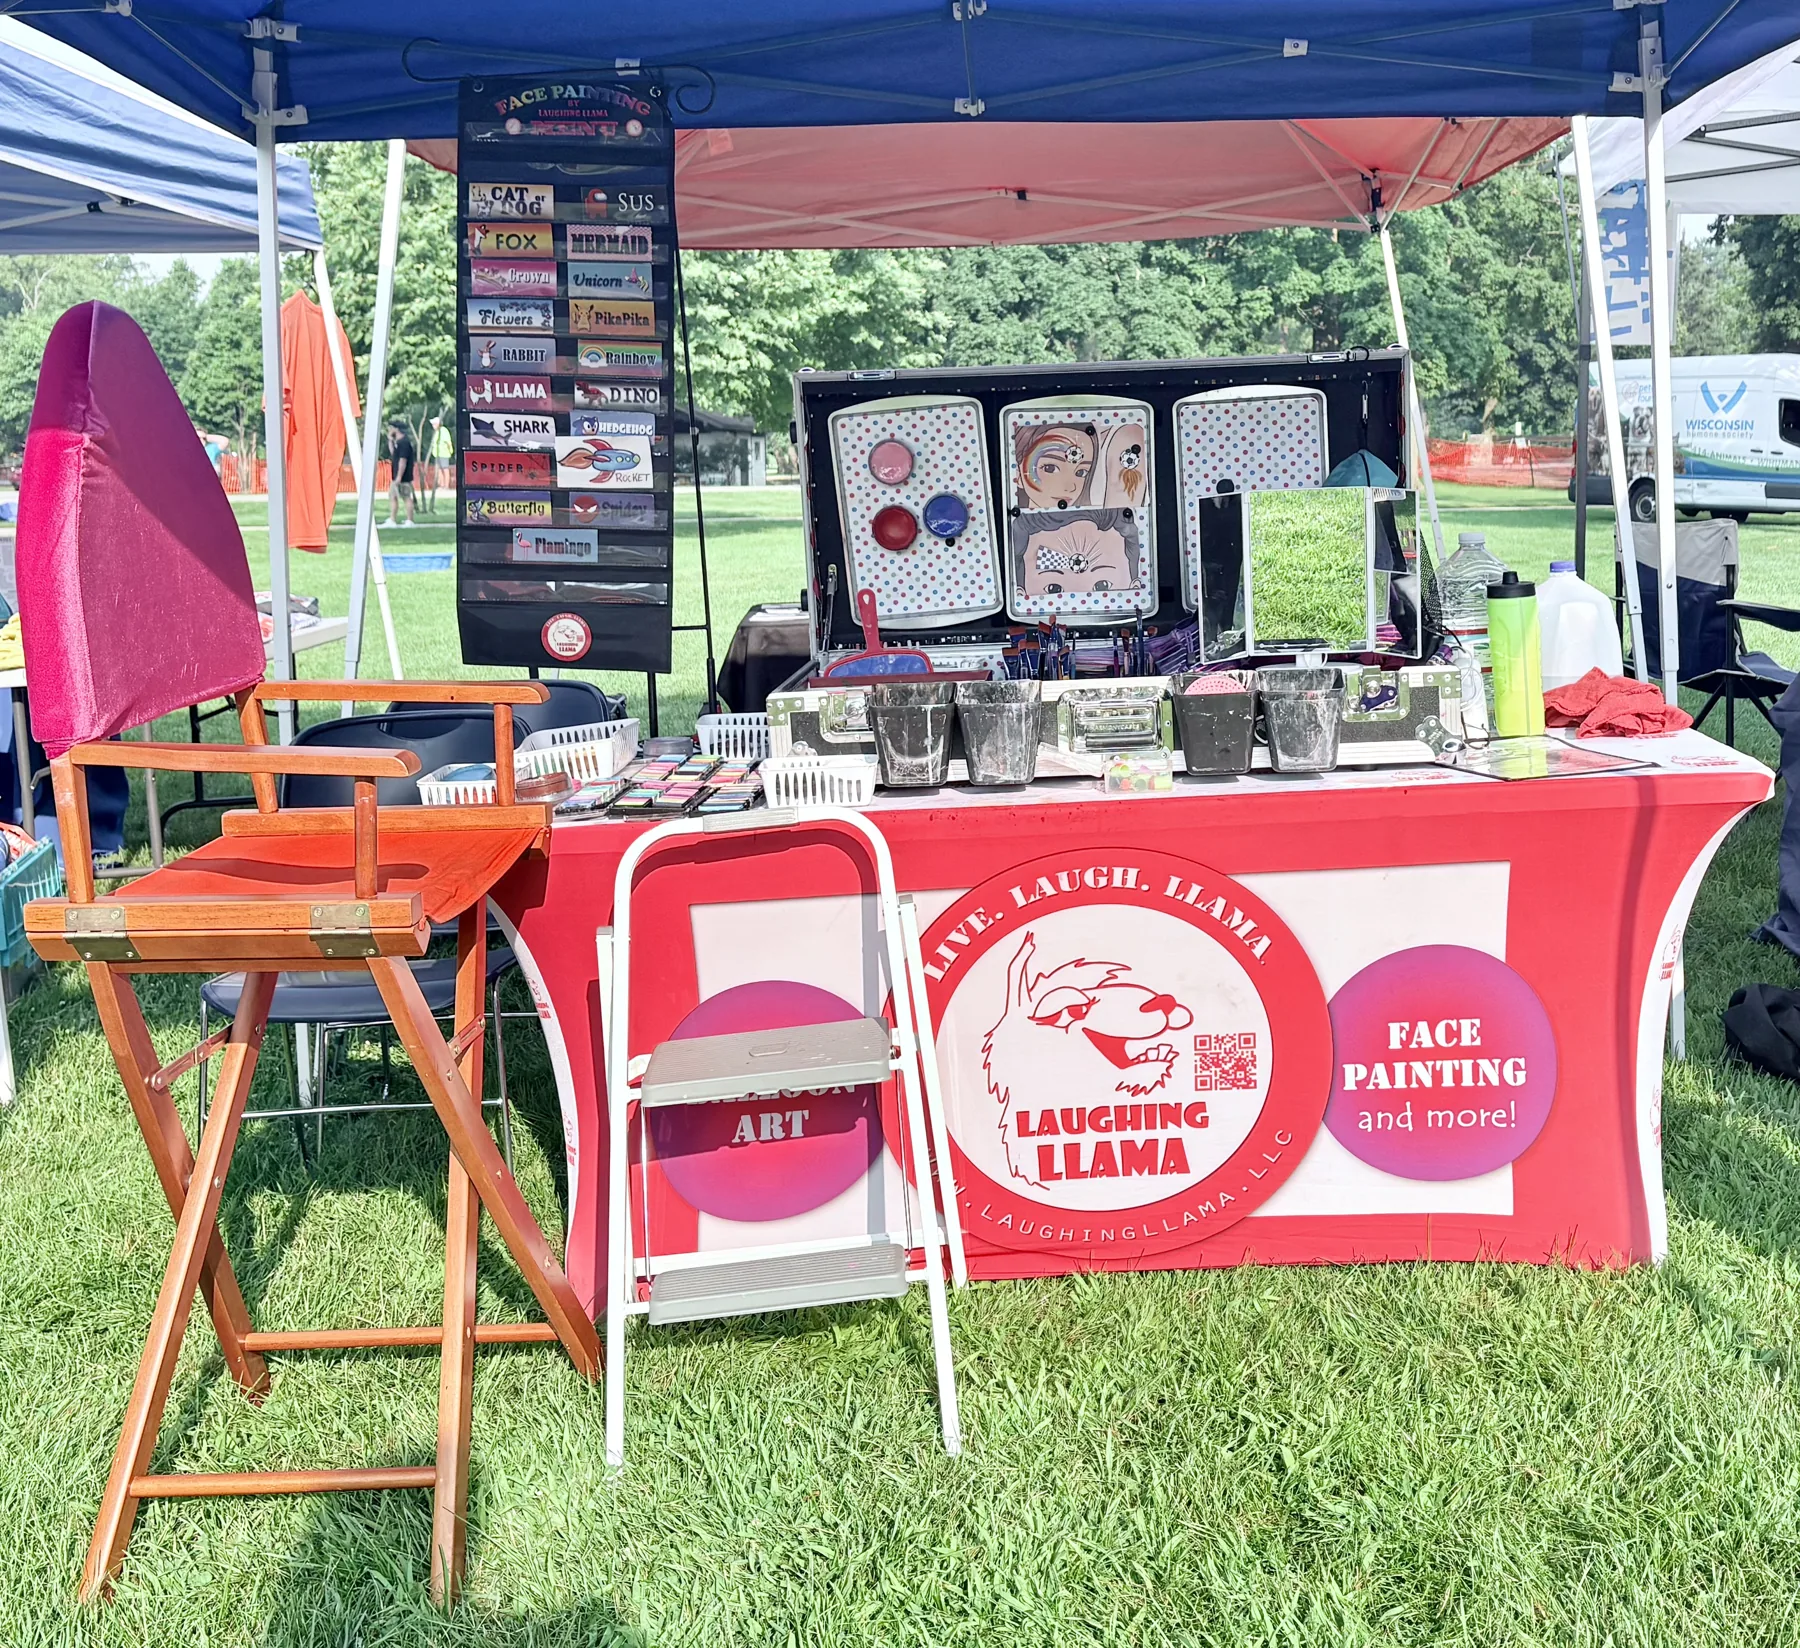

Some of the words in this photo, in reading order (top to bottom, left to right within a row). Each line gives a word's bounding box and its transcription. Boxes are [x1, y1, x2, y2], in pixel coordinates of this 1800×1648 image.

[494, 87, 548, 116] FACE
[550, 84, 651, 116] PAINTING
[567, 99, 580, 107] BY
[538, 109, 581, 117] LAUGHING
[582, 109, 608, 117] LLAMA
[529, 120, 619, 136] MENU
[491, 186, 529, 201] CAT
[535, 193, 547, 202] or
[617, 192, 655, 212] SUS
[501, 200, 542, 216] DOG
[495, 233, 537, 251] FOX
[570, 233, 650, 254] MERMAID
[508, 267, 550, 285] Crown
[572, 272, 623, 288] Unicorn
[478, 309, 533, 326] Flowers
[595, 311, 650, 326] PikaPika
[502, 348, 547, 363] RABBIT
[605, 351, 657, 366] Rainbow
[495, 382, 547, 399] LLAMA
[609, 387, 658, 404] DINO
[504, 419, 550, 434] SHARK
[598, 422, 653, 436] HEDGEHOG
[1685, 419, 1755, 430] WISCONSIN
[1686, 431, 1719, 439] humane
[1722, 430, 1754, 439] society
[471, 460, 524, 474] SPIDER
[486, 501, 545, 516] Butterfly
[535, 537, 592, 557] Flamingo
[923, 905, 1005, 984] LIVE.
[1008, 865, 1150, 909] LAUGH.
[1387, 1018, 1482, 1049] FACE
[1342, 1057, 1527, 1091] PAINTING
[1015, 1101, 1210, 1138] LAUGHING
[1358, 1101, 1414, 1132] and
[1426, 1100, 1517, 1129] more!
[731, 1109, 810, 1144] ART
[1036, 1137, 1191, 1182] LLAMA
